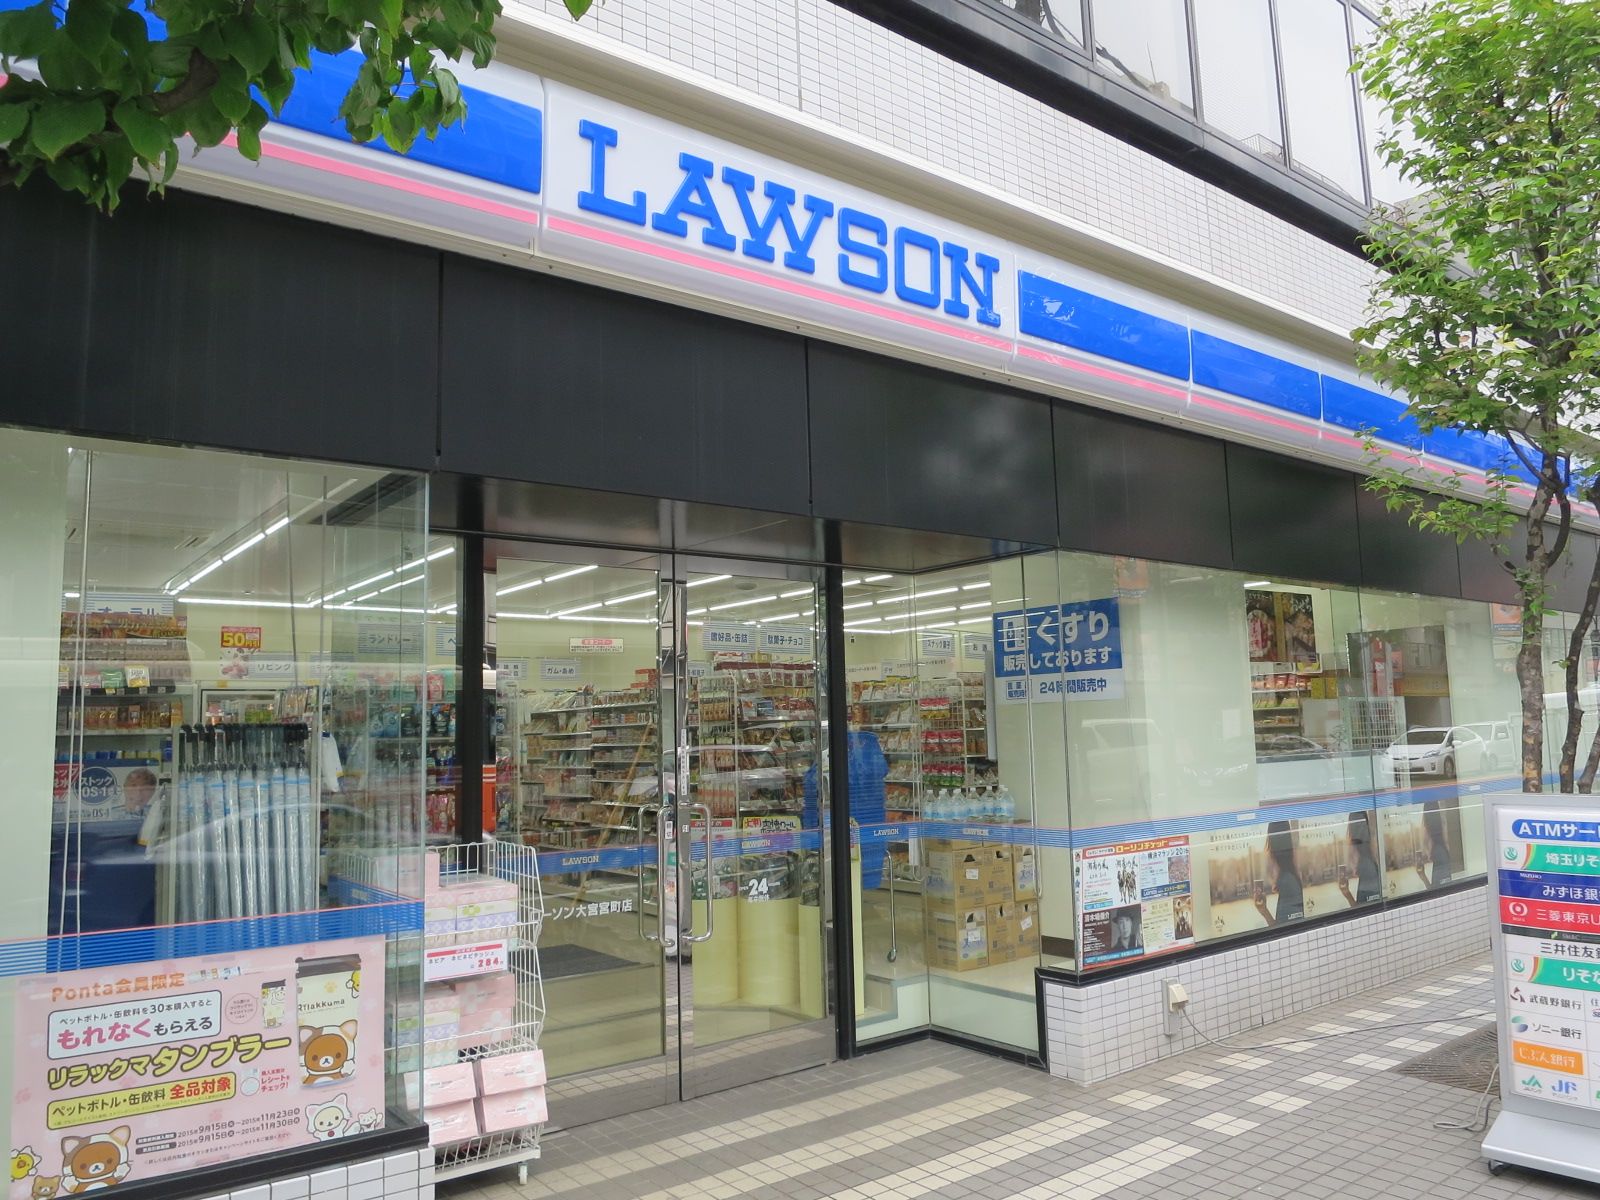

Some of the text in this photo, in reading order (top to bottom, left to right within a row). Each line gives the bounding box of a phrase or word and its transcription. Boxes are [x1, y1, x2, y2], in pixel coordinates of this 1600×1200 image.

[577, 119, 1000, 328] LAWSON
[1037, 610, 1109, 646] くすり
[368, 634, 410, 644] ランドリー
[257, 663, 292, 671] リビング
[1003, 646, 1112, 671] 販売しております
[1519, 821, 1600, 838] ATMサー
[562, 855, 599, 866] LAWSON
[748, 877, 769, 896] 24
[1542, 885, 1600, 901] みずほ銀
[52, 972, 185, 1002] Ponta会員限定
[1529, 995, 1581, 1010] 武蔵野銀行
[1532, 1023, 1581, 1039] ソニー銀行
[47, 1033, 293, 1091] リラックマタンブラー
[1519, 1046, 1576, 1069] じぶん銀行
[52, 1088, 165, 1117] ペットボトル・缶飲料
[170, 1076, 232, 1100] 全品対象
